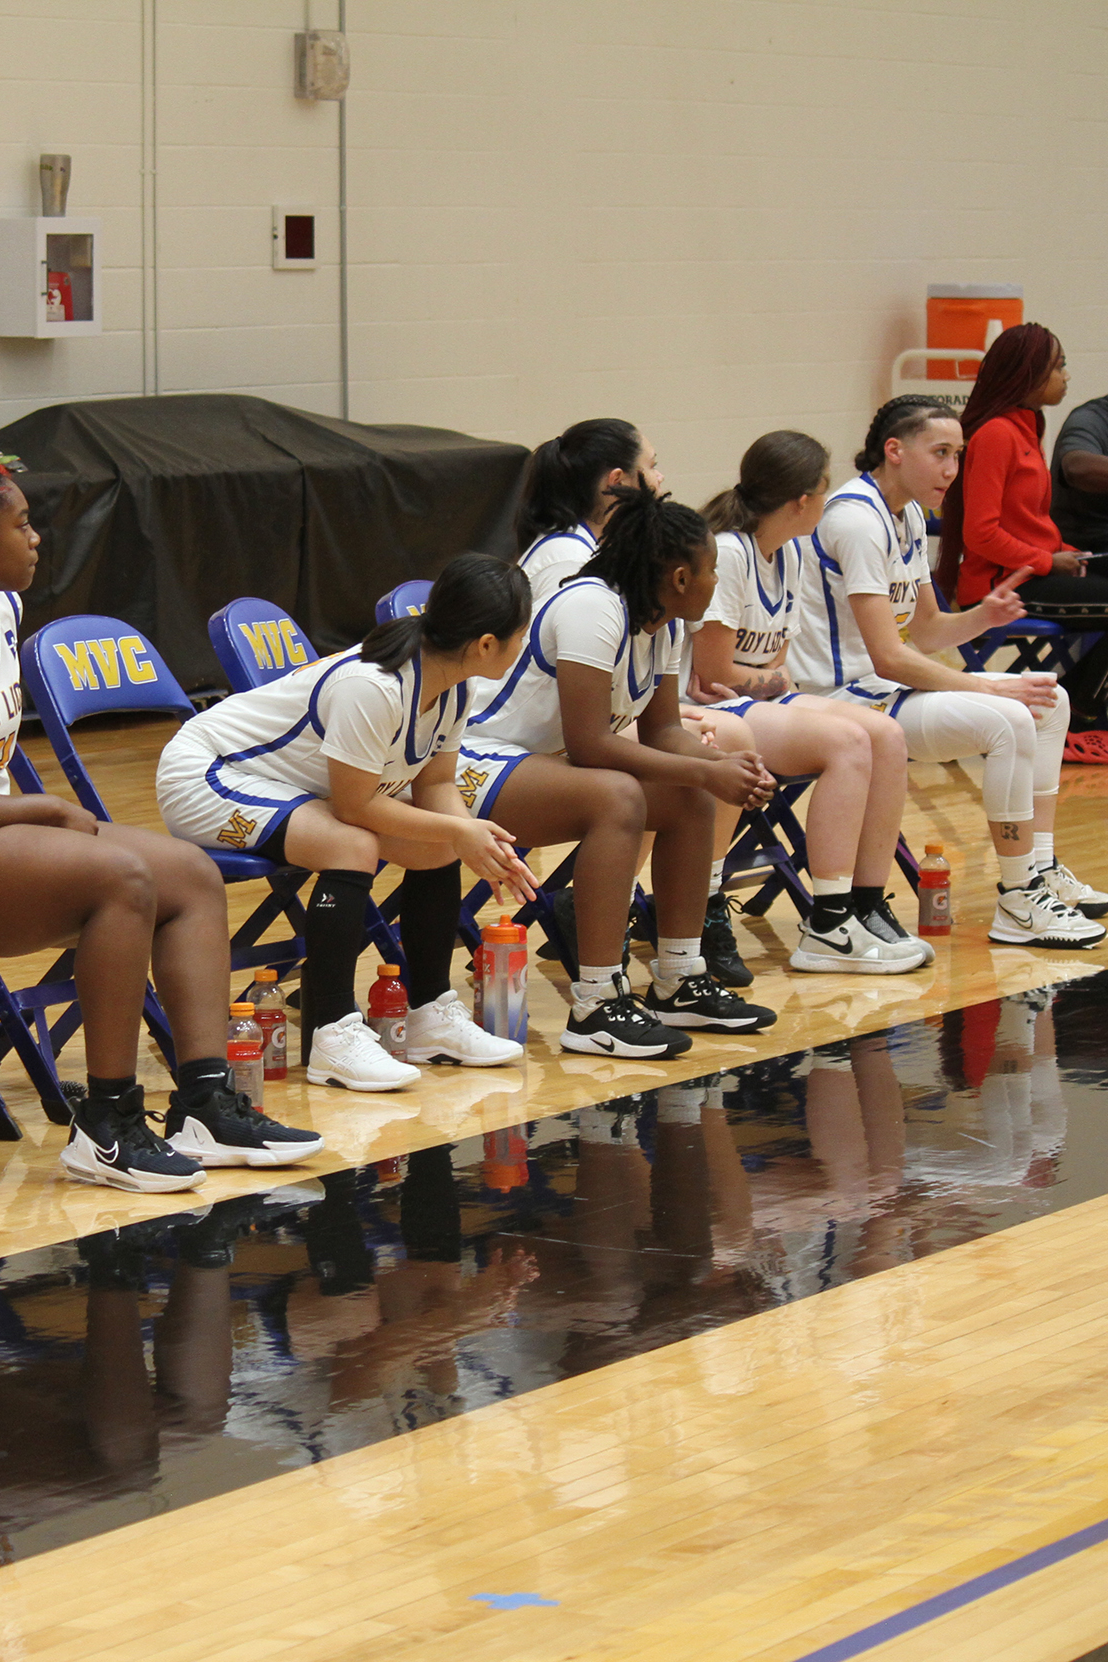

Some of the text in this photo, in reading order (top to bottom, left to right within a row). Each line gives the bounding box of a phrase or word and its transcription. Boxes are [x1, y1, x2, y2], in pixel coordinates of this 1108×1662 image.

[53, 635, 158, 690] MVC
[238, 618, 309, 669] MVC
[735, 628, 765, 653] ADY
[217, 809, 257, 849] M
